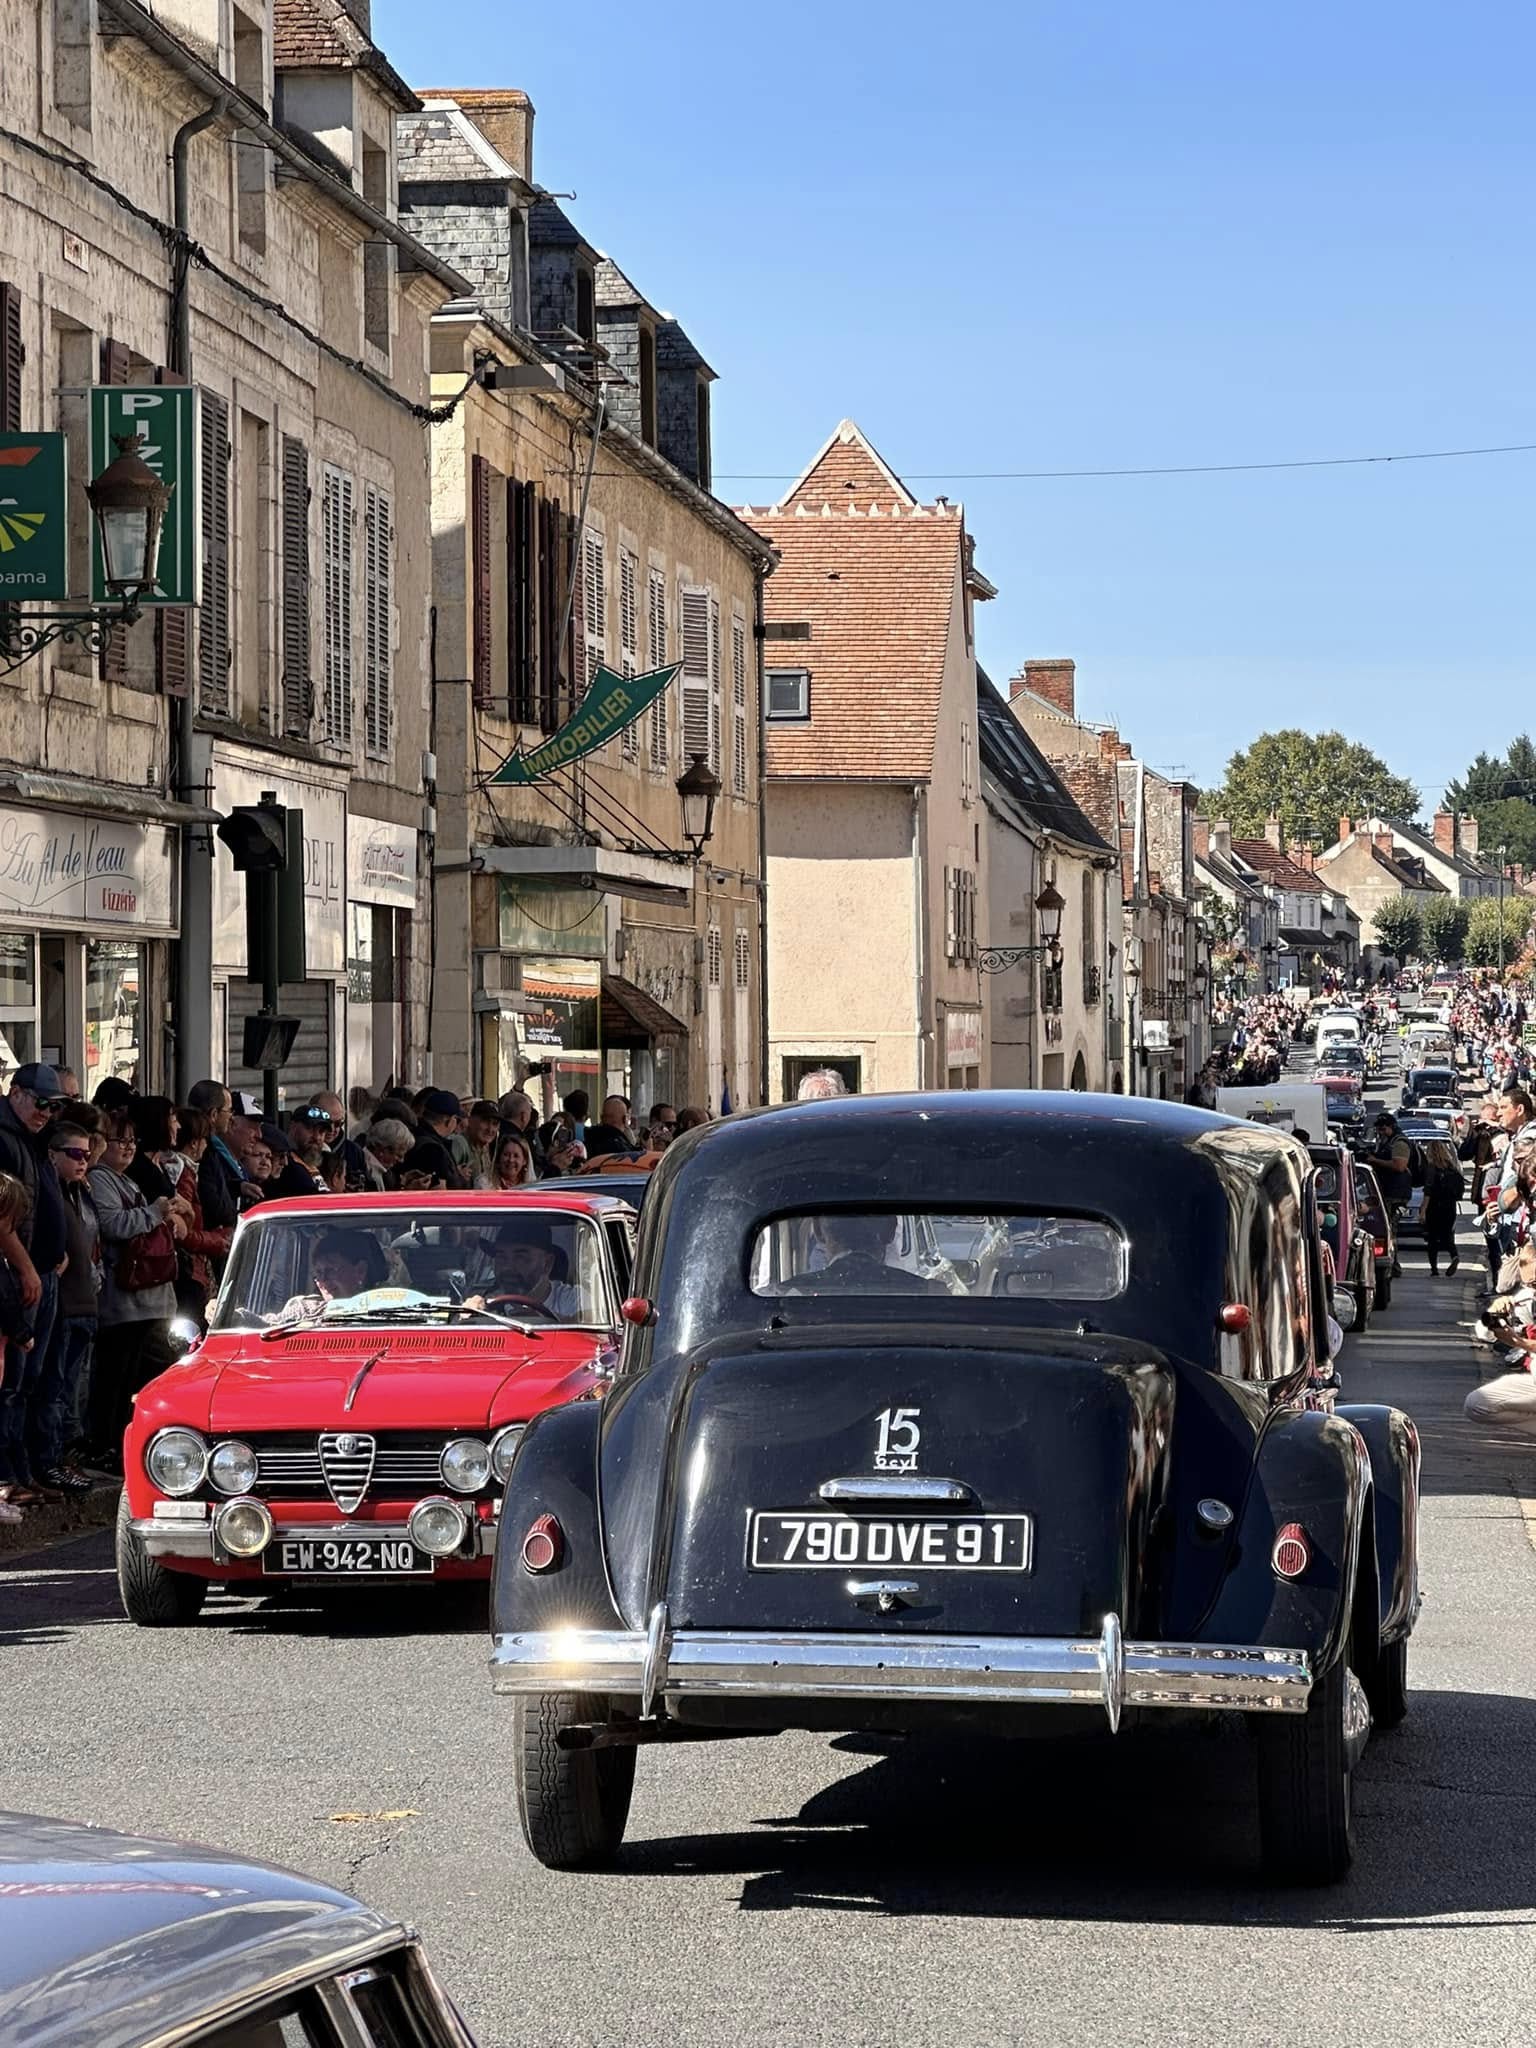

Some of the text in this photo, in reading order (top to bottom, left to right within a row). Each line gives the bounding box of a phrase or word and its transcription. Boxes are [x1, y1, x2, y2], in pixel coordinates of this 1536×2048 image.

[522, 687, 633, 776] IMMOBILIER
[31, 836, 59, 906] fil
[61, 833, 82, 882] de
[86, 824, 127, 875] l'eau
[874, 1408, 921, 1456] 15
[281, 1542, 415, 1571] EW-942-NQ
[780, 1521, 1005, 1564] 790 DVE 91
